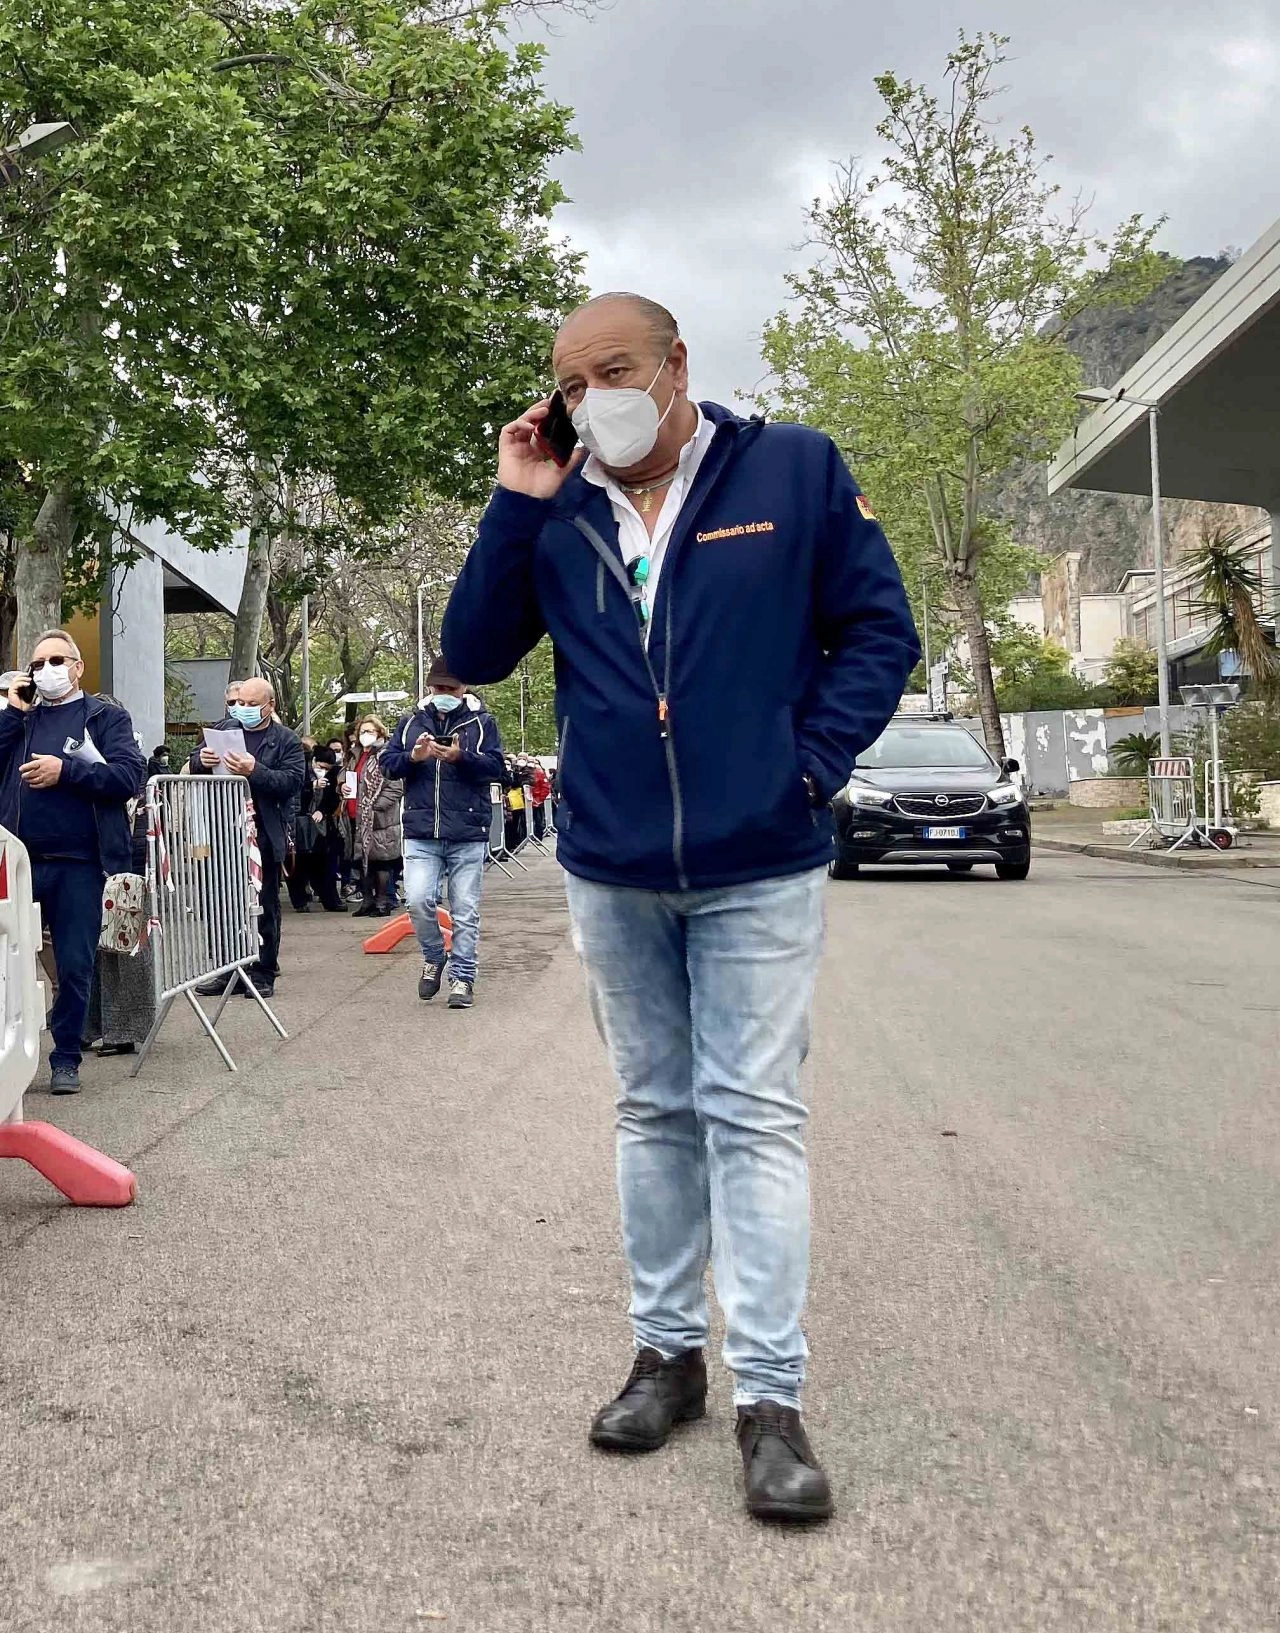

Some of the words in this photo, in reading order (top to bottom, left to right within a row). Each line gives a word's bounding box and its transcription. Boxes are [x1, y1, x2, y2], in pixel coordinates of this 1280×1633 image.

[696, 524, 744, 543] Commissario
[745, 522, 755, 533] ad
[756, 521, 774, 532] acta
